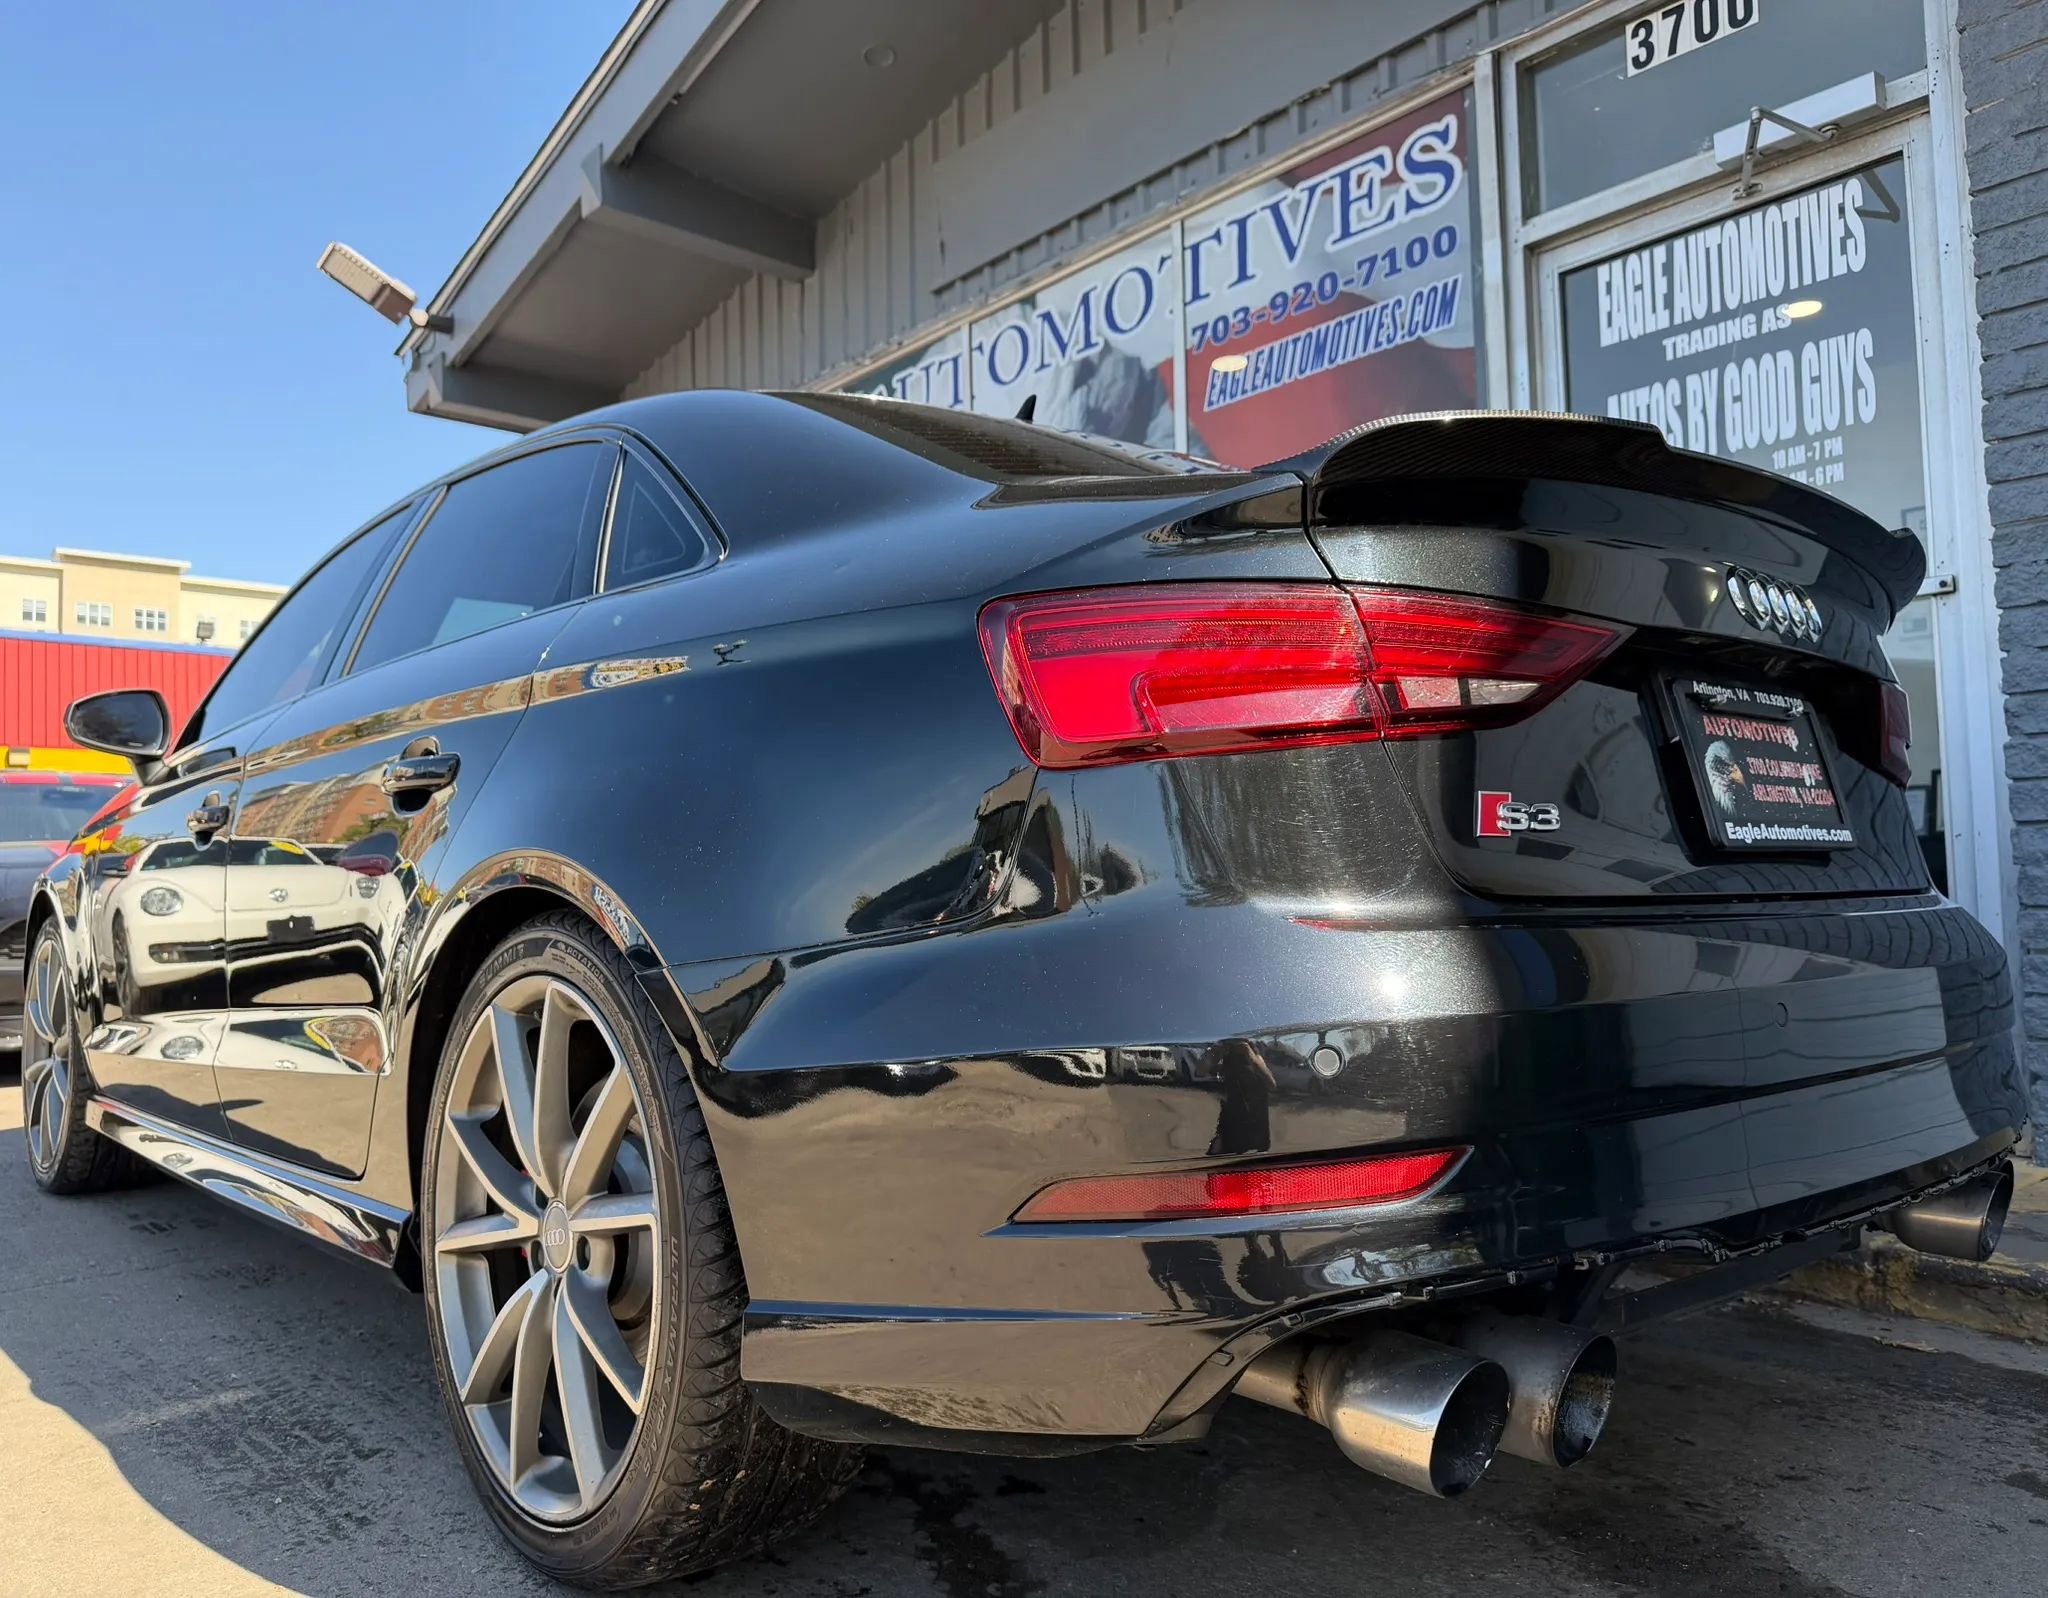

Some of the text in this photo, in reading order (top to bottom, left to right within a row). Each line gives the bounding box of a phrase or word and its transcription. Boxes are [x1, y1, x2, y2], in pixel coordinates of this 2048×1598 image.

[884, 121, 1456, 408] UTOMOTIVES
[1191, 225, 1458, 352] 703-920-7100
[1597, 178, 1867, 348] EAGLE AUTOMOTIVES
[1206, 278, 1459, 408] EAGLEAUTOMOTIVES.COM
[1662, 303, 1793, 362] TRADING AS
[1686, 366, 1719, 456] BY
[1723, 349, 1797, 454] GOOD
[1801, 327, 1877, 436] GUYS
[1824, 436, 1843, 458] PM
[1825, 461, 1844, 484] PM
[1735, 688, 1751, 702] VA
[1496, 801, 1561, 831] S3
[1724, 821, 1853, 844] EagleAutomotives.com
[663, 1235, 680, 1393] ULTRAMAX
